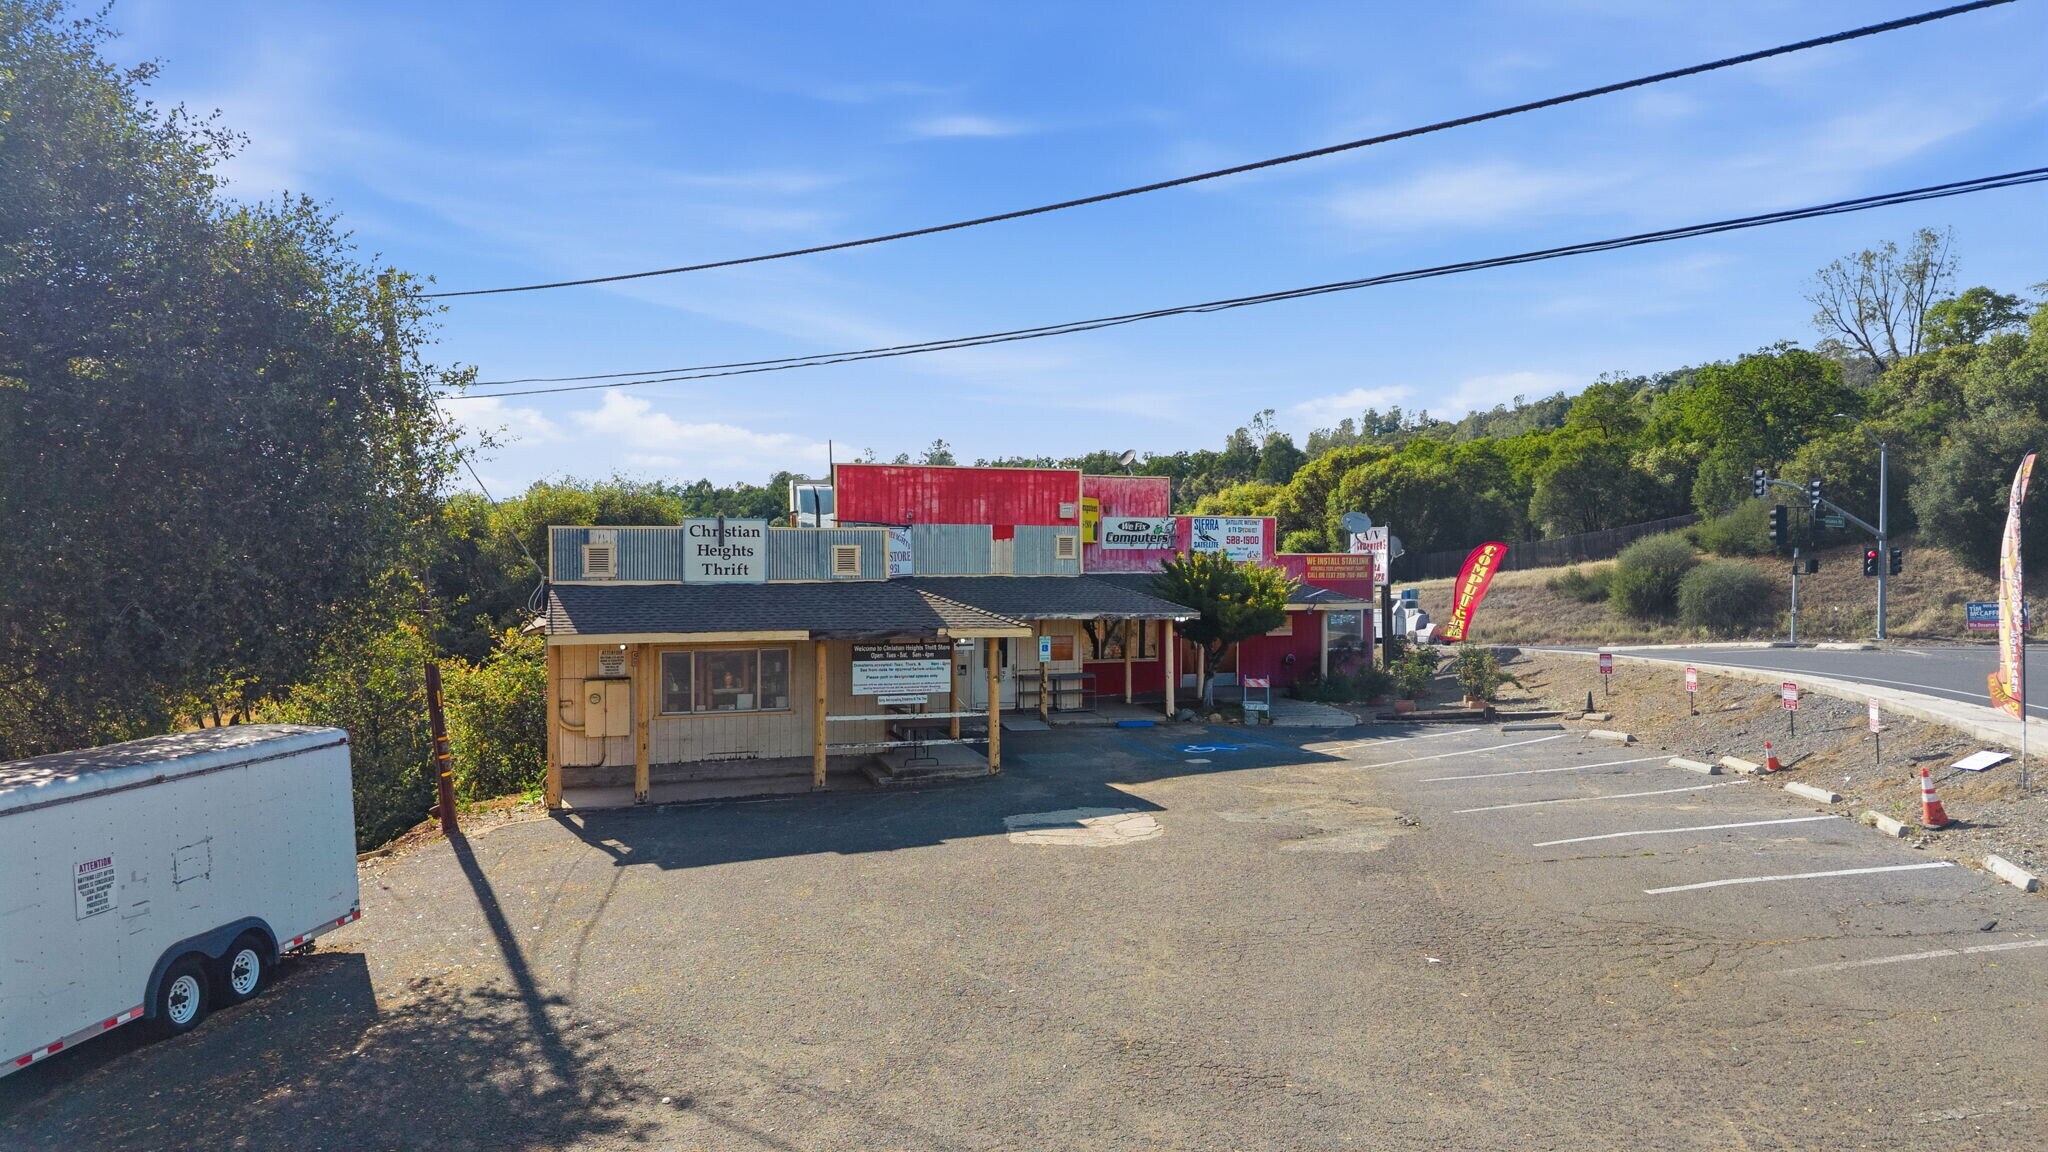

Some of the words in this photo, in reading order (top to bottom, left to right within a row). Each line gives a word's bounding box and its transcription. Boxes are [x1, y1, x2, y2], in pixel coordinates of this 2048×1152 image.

[1121, 522, 1134, 531] We
[1135, 523, 1147, 531] Fix
[1194, 519, 1219, 531] SIERRA
[689, 524, 761, 538] Chrstian
[1105, 532, 1168, 546] Computers
[1193, 541, 1219, 549] SATELLITE
[697, 544, 754, 561] Heights
[890, 551, 911, 562] STORE
[1307, 557, 1317, 565] WE
[1318, 557, 1340, 565] INSTALL
[1341, 557, 1369, 565] STARLINK
[701, 563, 750, 576] Thrift
[906, 644, 924, 652] Heights
[79, 856, 111, 874] ATTENTION
[78, 874, 94, 884] ANYTHING
[95, 871, 103, 879] LEFT
[104, 868, 114, 877] AFTER
[78, 882, 89, 891] HOURS
[95, 892, 103, 900] WILL
